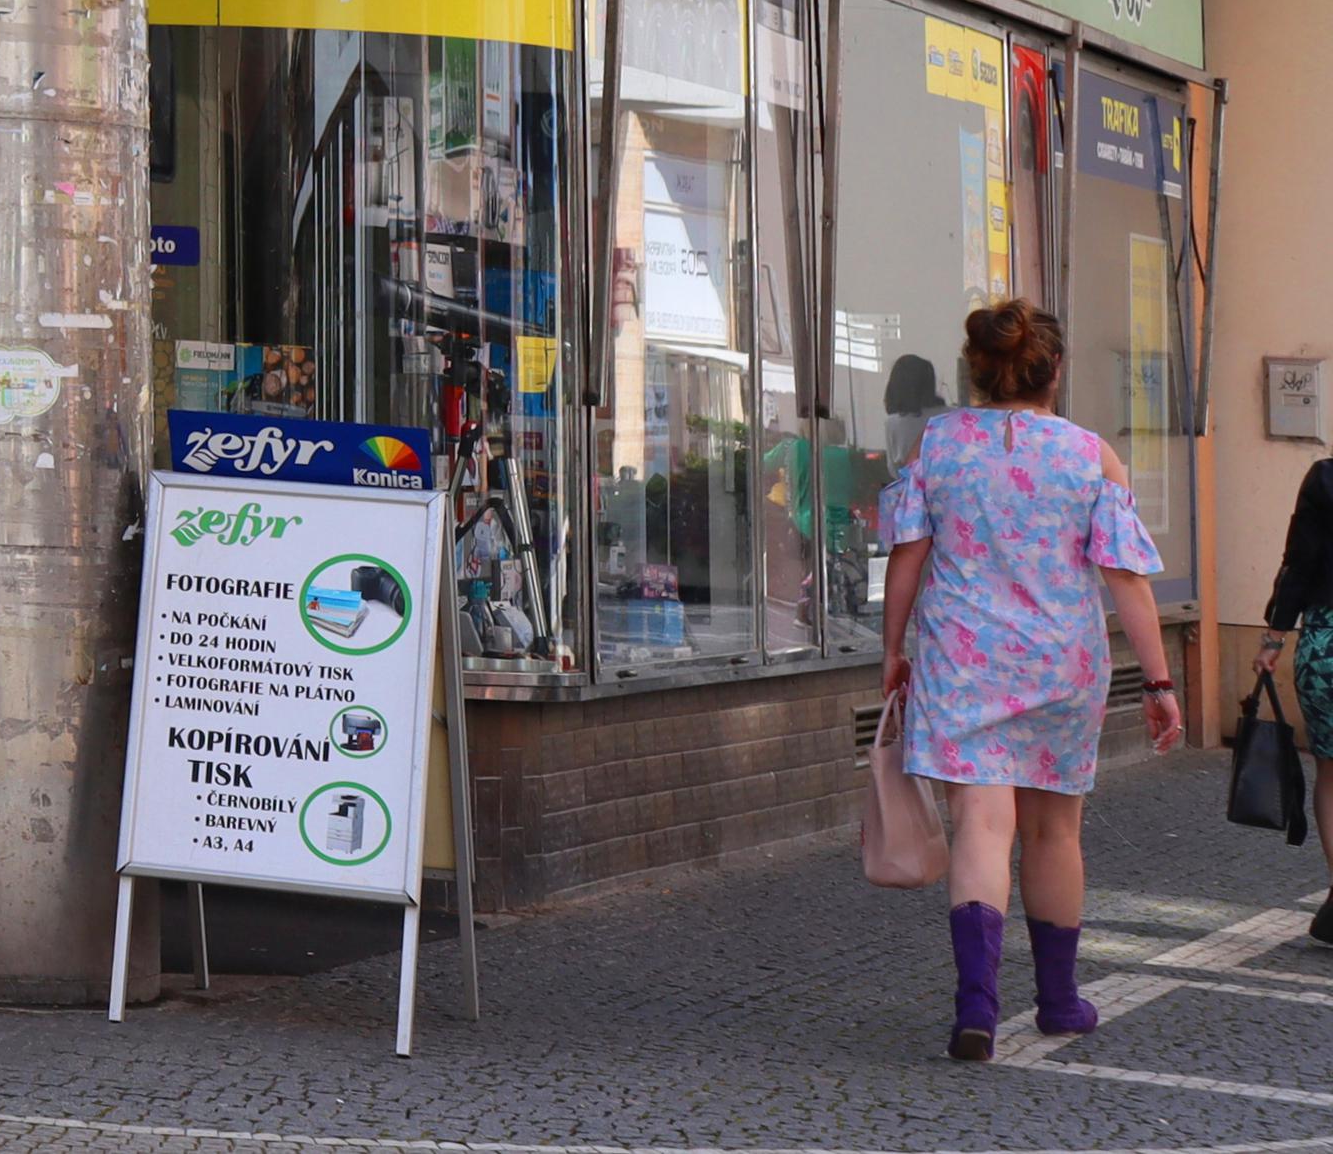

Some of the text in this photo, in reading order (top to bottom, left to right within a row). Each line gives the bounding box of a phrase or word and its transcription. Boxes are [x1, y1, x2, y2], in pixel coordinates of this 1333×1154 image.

[1101, 96, 1140, 139] TRAFIKA
[193, 350, 231, 360] FIELDMANN
[353, 467, 424, 490] Konica
[166, 573, 295, 601] FOTOGRAFIE
[171, 611, 267, 632] NA POČKÁNÍ
[170, 632, 277, 654] DO 24 HODIN
[168, 653, 354, 681] VELKOFORMÁTOVÝ TISK
[167, 674, 356, 703] FOTOGRAFIE NA PLÁTNO
[165, 695, 260, 717] LAMINOVÁNÍ
[168, 726, 331, 763] KOPÍROVÁNÍ
[187, 759, 254, 789] TISK
[206, 790, 299, 815] ČERNOBÍLÝ
[205, 814, 278, 834] BAREVNÝ
[202, 836, 254, 853] A3, A4
